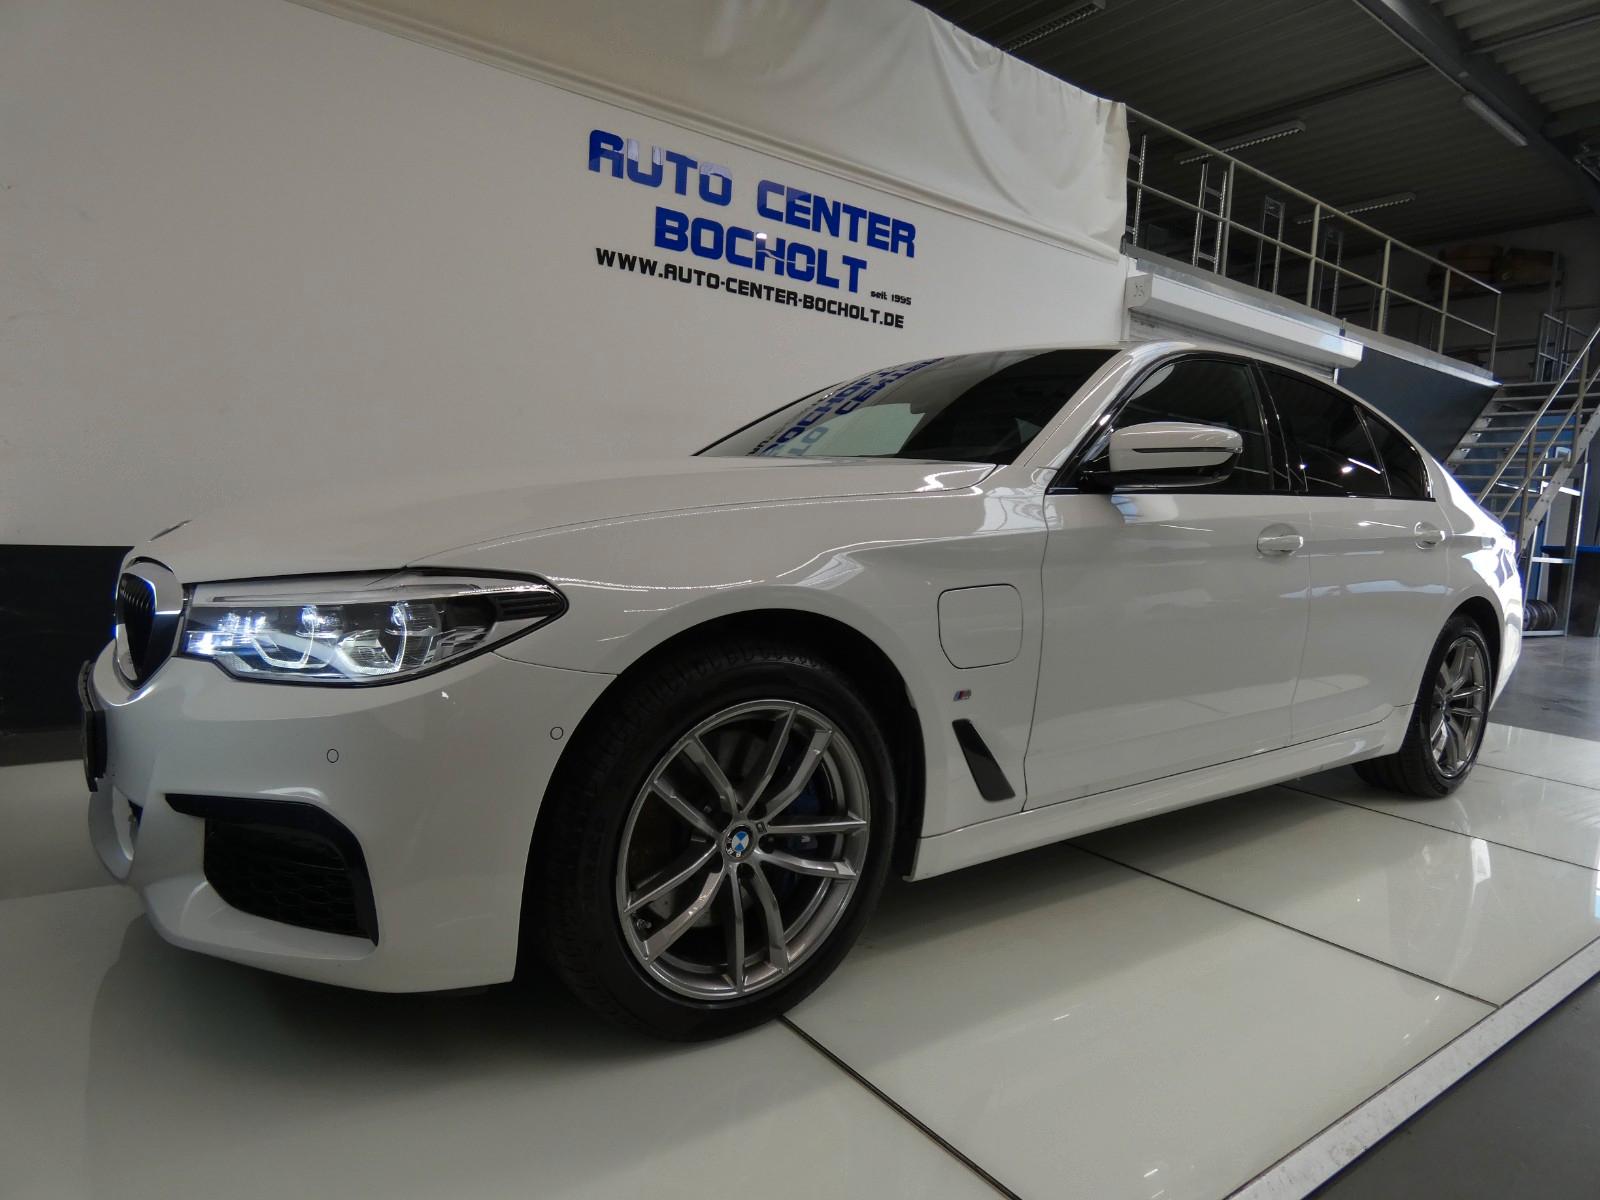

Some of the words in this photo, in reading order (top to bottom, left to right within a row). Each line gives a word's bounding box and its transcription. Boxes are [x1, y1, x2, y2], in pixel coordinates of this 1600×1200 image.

[588, 129, 733, 207] AUTO
[756, 179, 917, 258] CENTER
[596, 247, 905, 329] WWW.AUTO-CENTER-BOCHOLT.DE
[654, 206, 868, 293] BOCHOLT
[891, 293, 912, 306] 1995
